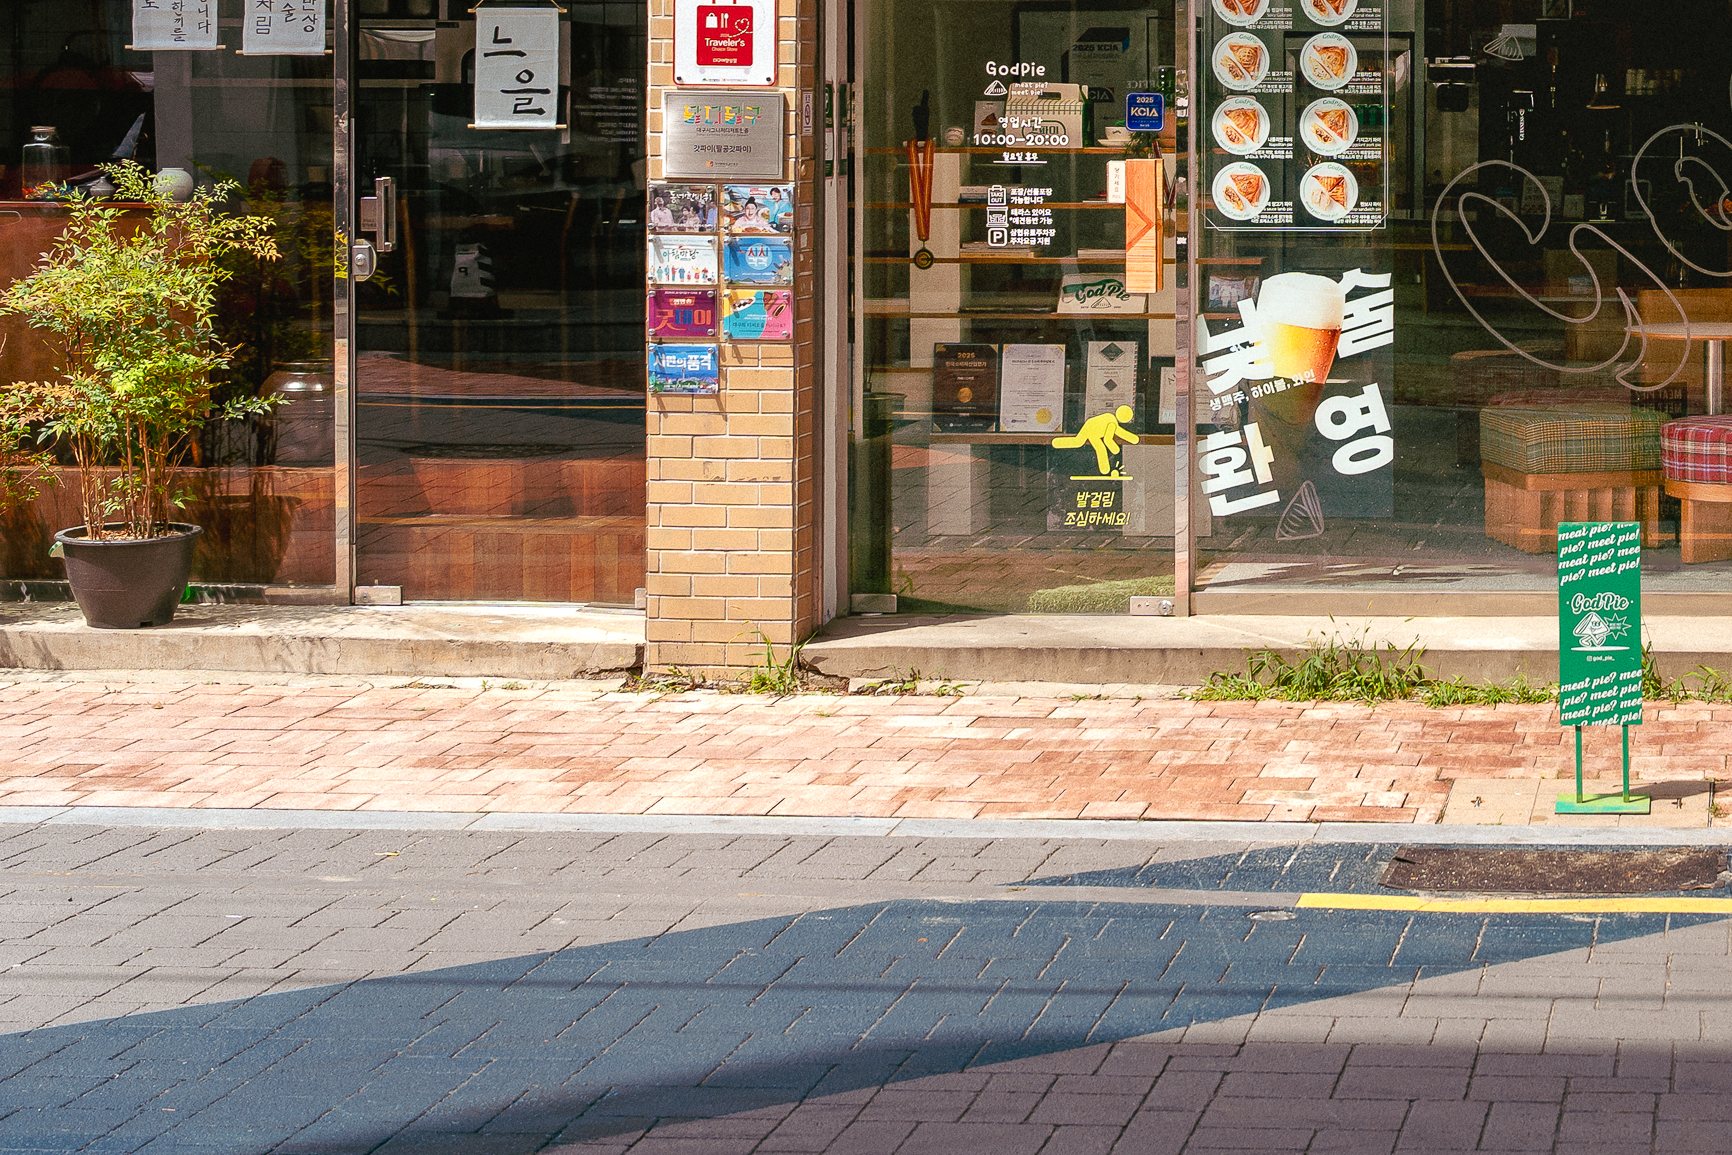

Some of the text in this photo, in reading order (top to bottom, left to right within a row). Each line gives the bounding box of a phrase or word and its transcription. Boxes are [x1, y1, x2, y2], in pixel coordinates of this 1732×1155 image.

[170, 0, 187, 42] 한끼를
[704, 37, 746, 48] Traveler's
[483, 25, 551, 116] 느을
[986, 61, 1045, 77] GodPie
[1130, 107, 1159, 117] KCIA
[998, 117, 1043, 129] 영업시간
[655, 309, 712, 331] 굿데이
[1076, 491, 1116, 508] 발걸림
[1063, 511, 1132, 526] 조심하세요!
[1558, 527, 1588, 541] meat
[1560, 529, 1640, 558] pie? meet pie!
[1558, 555, 1588, 569] meat
[1589, 548, 1615, 566] pie?
[1560, 557, 1640, 587] pie? meet pie!
[1561, 678, 1590, 692] meat
[1591, 672, 1617, 690] pie?
[1562, 681, 1642, 709] pie? meet pie!
[1561, 707, 1591, 721] meat
[1592, 701, 1617, 718] pie?
